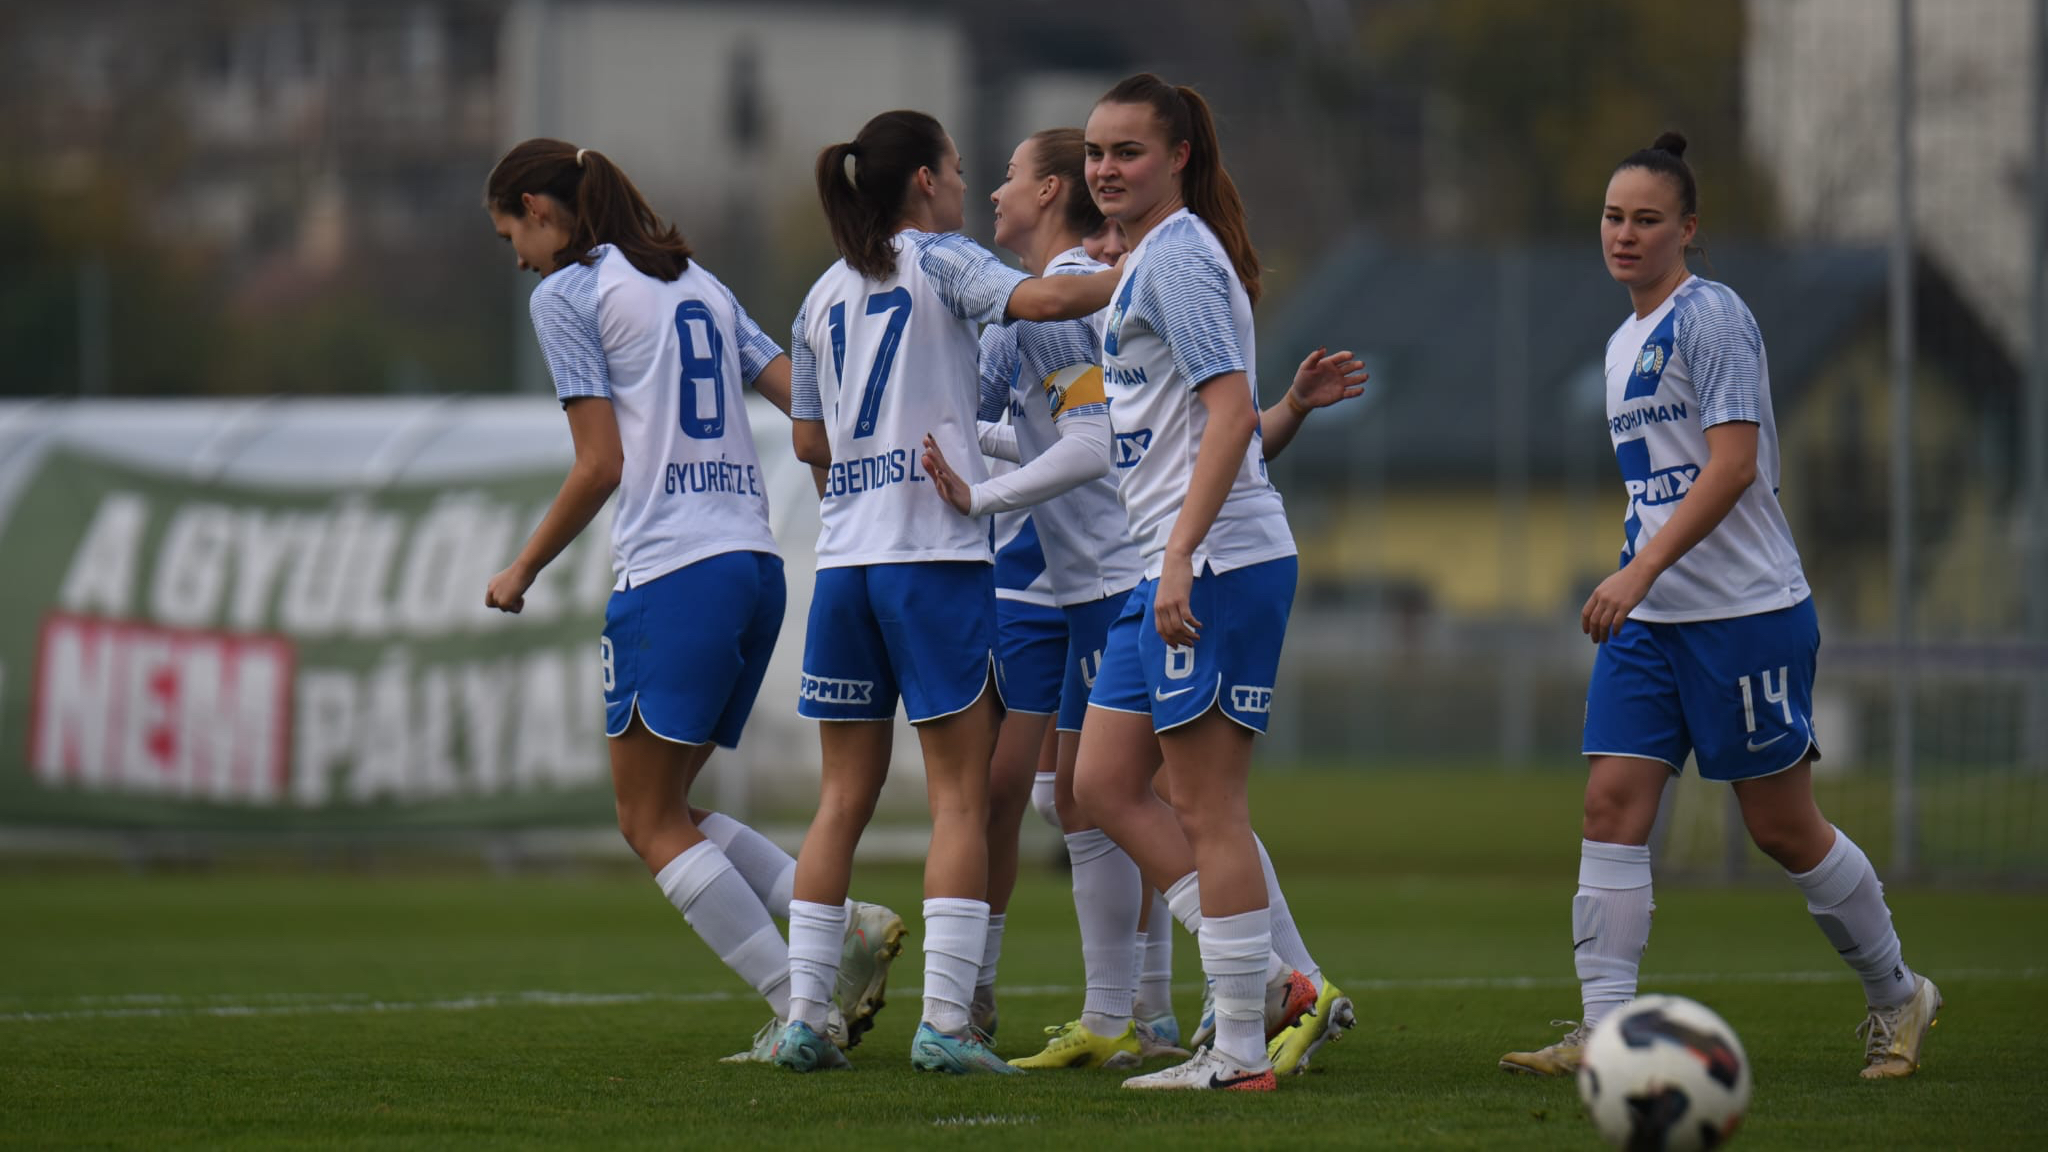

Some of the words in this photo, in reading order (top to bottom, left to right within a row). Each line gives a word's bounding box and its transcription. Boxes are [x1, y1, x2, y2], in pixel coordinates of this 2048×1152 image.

[675, 300, 725, 439] 8
[828, 286, 912, 440] 17
[746, 465, 761, 497] E.
[910, 449, 926, 481] L.
[62, 491, 150, 616] A
[36, 621, 282, 803] NEM
[1739, 666, 1794, 732] 14
